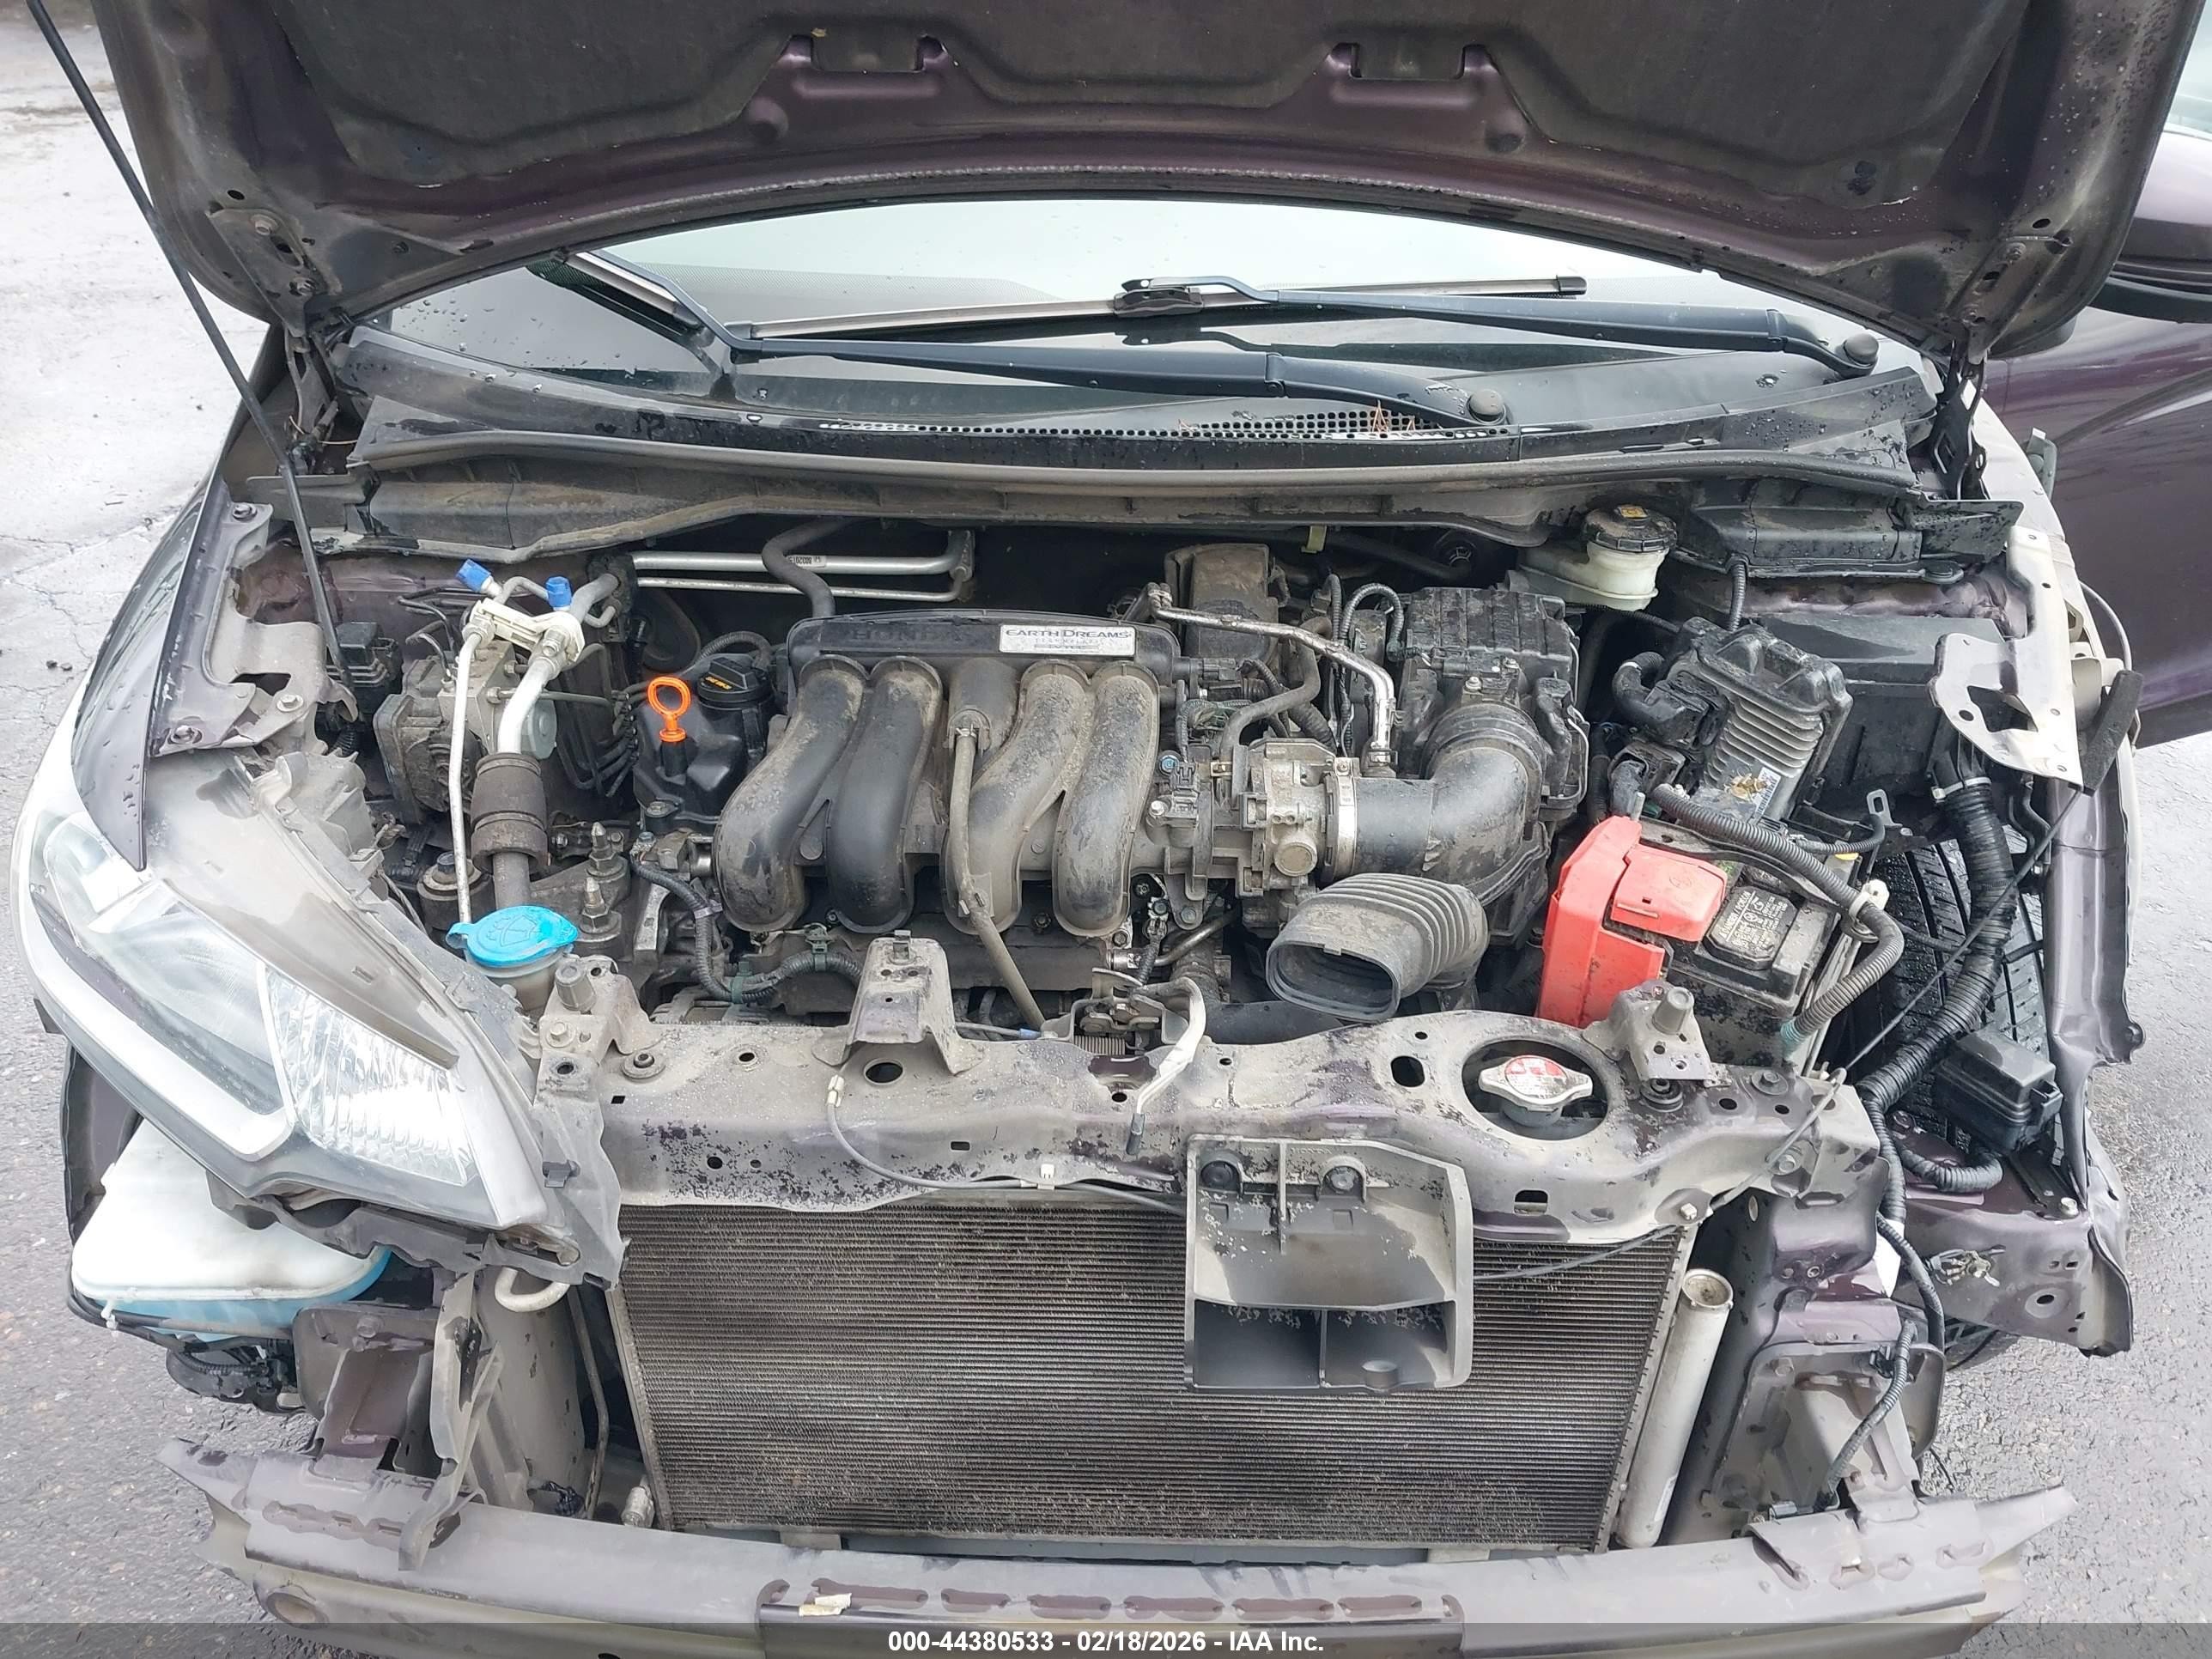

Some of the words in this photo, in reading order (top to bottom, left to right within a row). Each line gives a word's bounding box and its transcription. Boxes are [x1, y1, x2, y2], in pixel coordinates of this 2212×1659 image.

[852, 629, 963, 641] HONDA
[1006, 629, 1059, 638] EARTH
[1063, 629, 1129, 639] DREAMS
